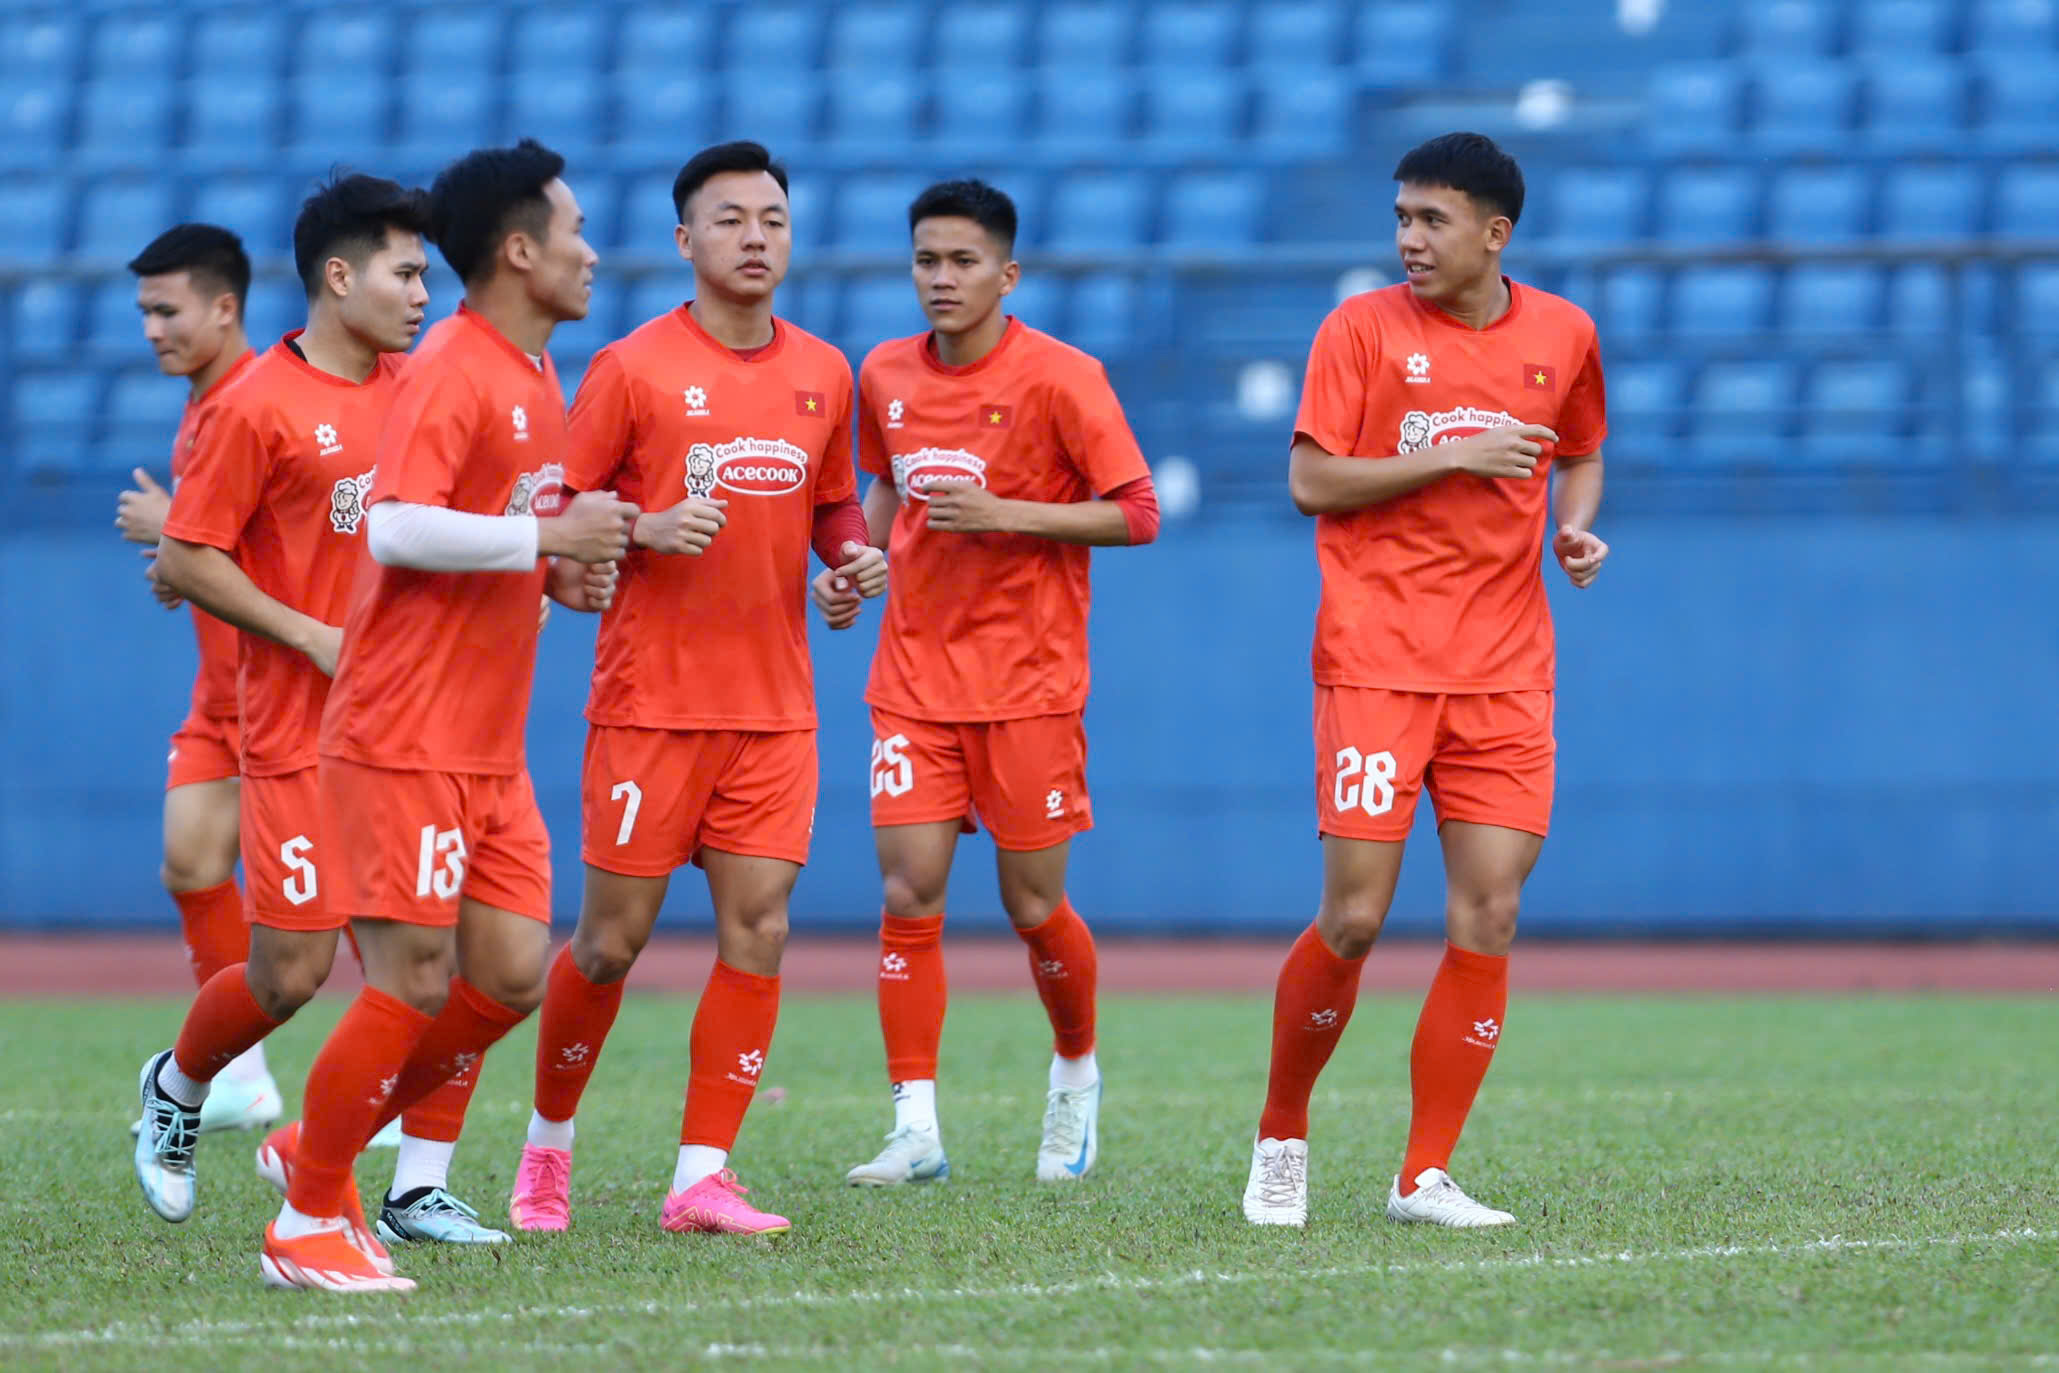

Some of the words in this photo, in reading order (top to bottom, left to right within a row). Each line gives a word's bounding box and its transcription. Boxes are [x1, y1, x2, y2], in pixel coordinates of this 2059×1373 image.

[716, 440, 746, 458] Cook
[749, 439, 805, 462] happiness
[1433, 409, 1464, 426] Cook
[1469, 409, 1518, 427] happin
[871, 733, 913, 798] 25
[1334, 745, 1397, 816] 28
[611, 780, 642, 846] 7
[280, 834, 318, 905] 5
[416, 823, 468, 899] 13
